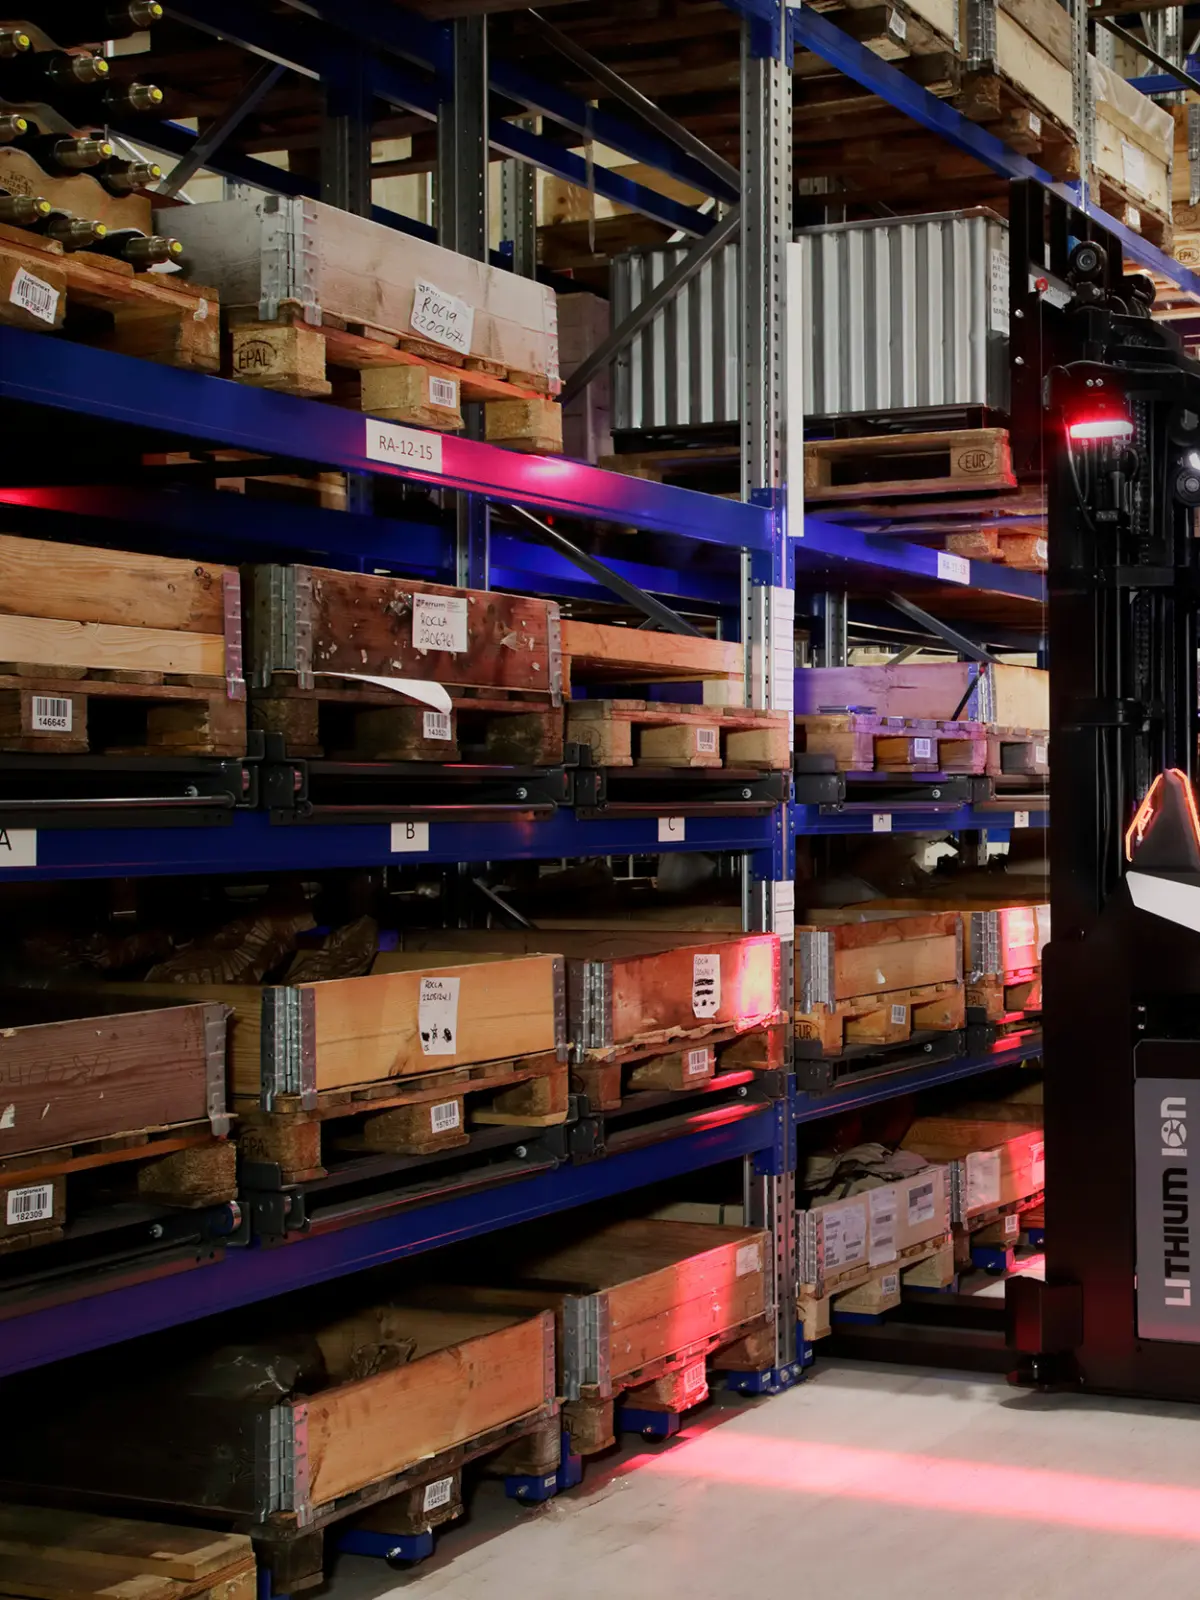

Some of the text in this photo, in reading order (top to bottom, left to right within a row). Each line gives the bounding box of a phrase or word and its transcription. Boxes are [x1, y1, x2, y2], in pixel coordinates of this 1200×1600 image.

[239, 348, 270, 369] EPAL
[379, 435, 432, 460] RA-12-15
[965, 453, 985, 469] EUR
[38, 717, 66, 728] 146645
[406, 821, 415, 840] B
[667, 817, 676, 831] C
[0, 829, 12, 851] A
[794, 1024, 812, 1039] EUR
[16, 1187, 45, 1196] Logisnext
[16, 1210, 43, 1222] 182309
[1163, 1168, 1191, 1307] LITHIUM
